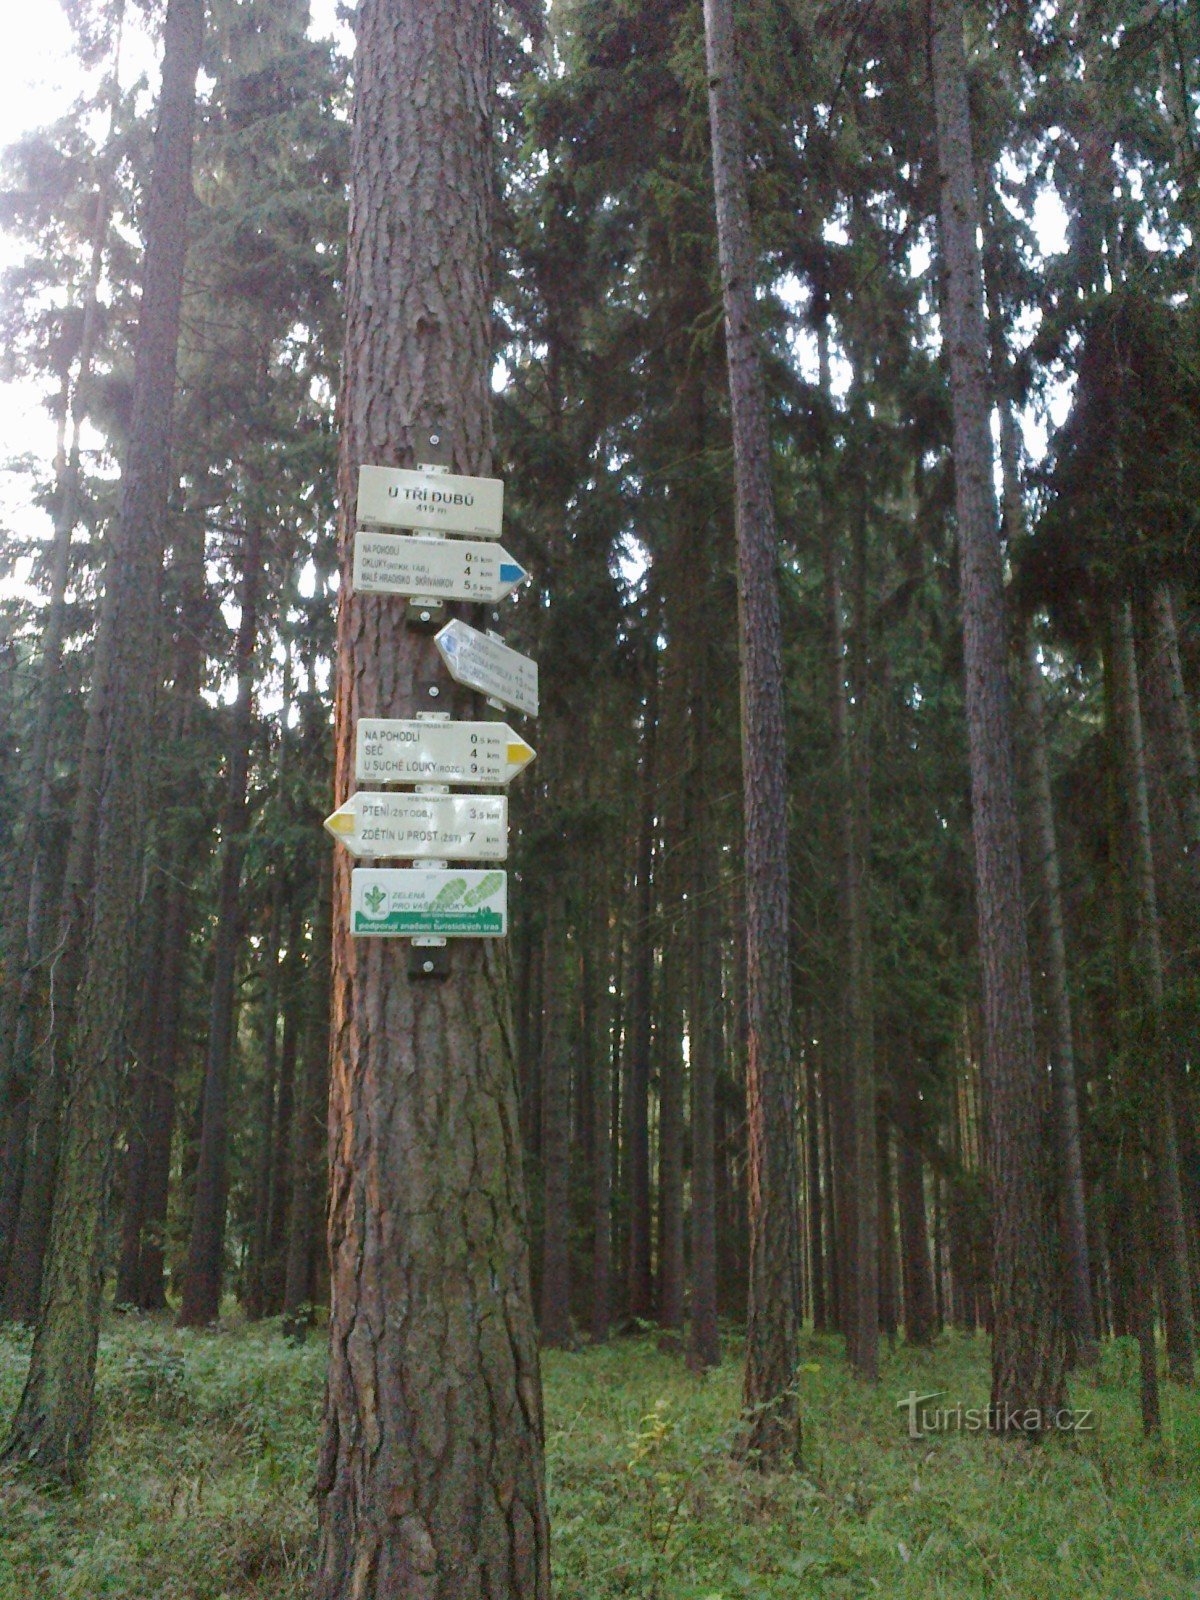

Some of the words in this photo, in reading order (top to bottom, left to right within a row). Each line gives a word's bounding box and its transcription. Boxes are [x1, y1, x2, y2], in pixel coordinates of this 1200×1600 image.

[388, 486, 398, 498] U
[431, 491, 474, 507] DUBŮ
[416, 503, 435, 512] 419
[480, 555, 493, 563] km
[464, 566, 471, 576] 4
[365, 730, 378, 740] NA
[487, 737, 500, 745] km
[365, 744, 384, 756] SEČ
[470, 748, 478, 758] 4
[364, 761, 371, 771] U
[373, 759, 405, 771] SUCHÉ
[406, 761, 438, 772] LOUKY
[362, 803, 390, 817] PTENÍ
[470, 807, 485, 820] 3,5
[486, 812, 500, 820] km
[361, 827, 395, 840] ZDĚTÍN
[398, 830, 404, 841] U
[469, 832, 476, 842] 7
[392, 902, 410, 910] PRO
